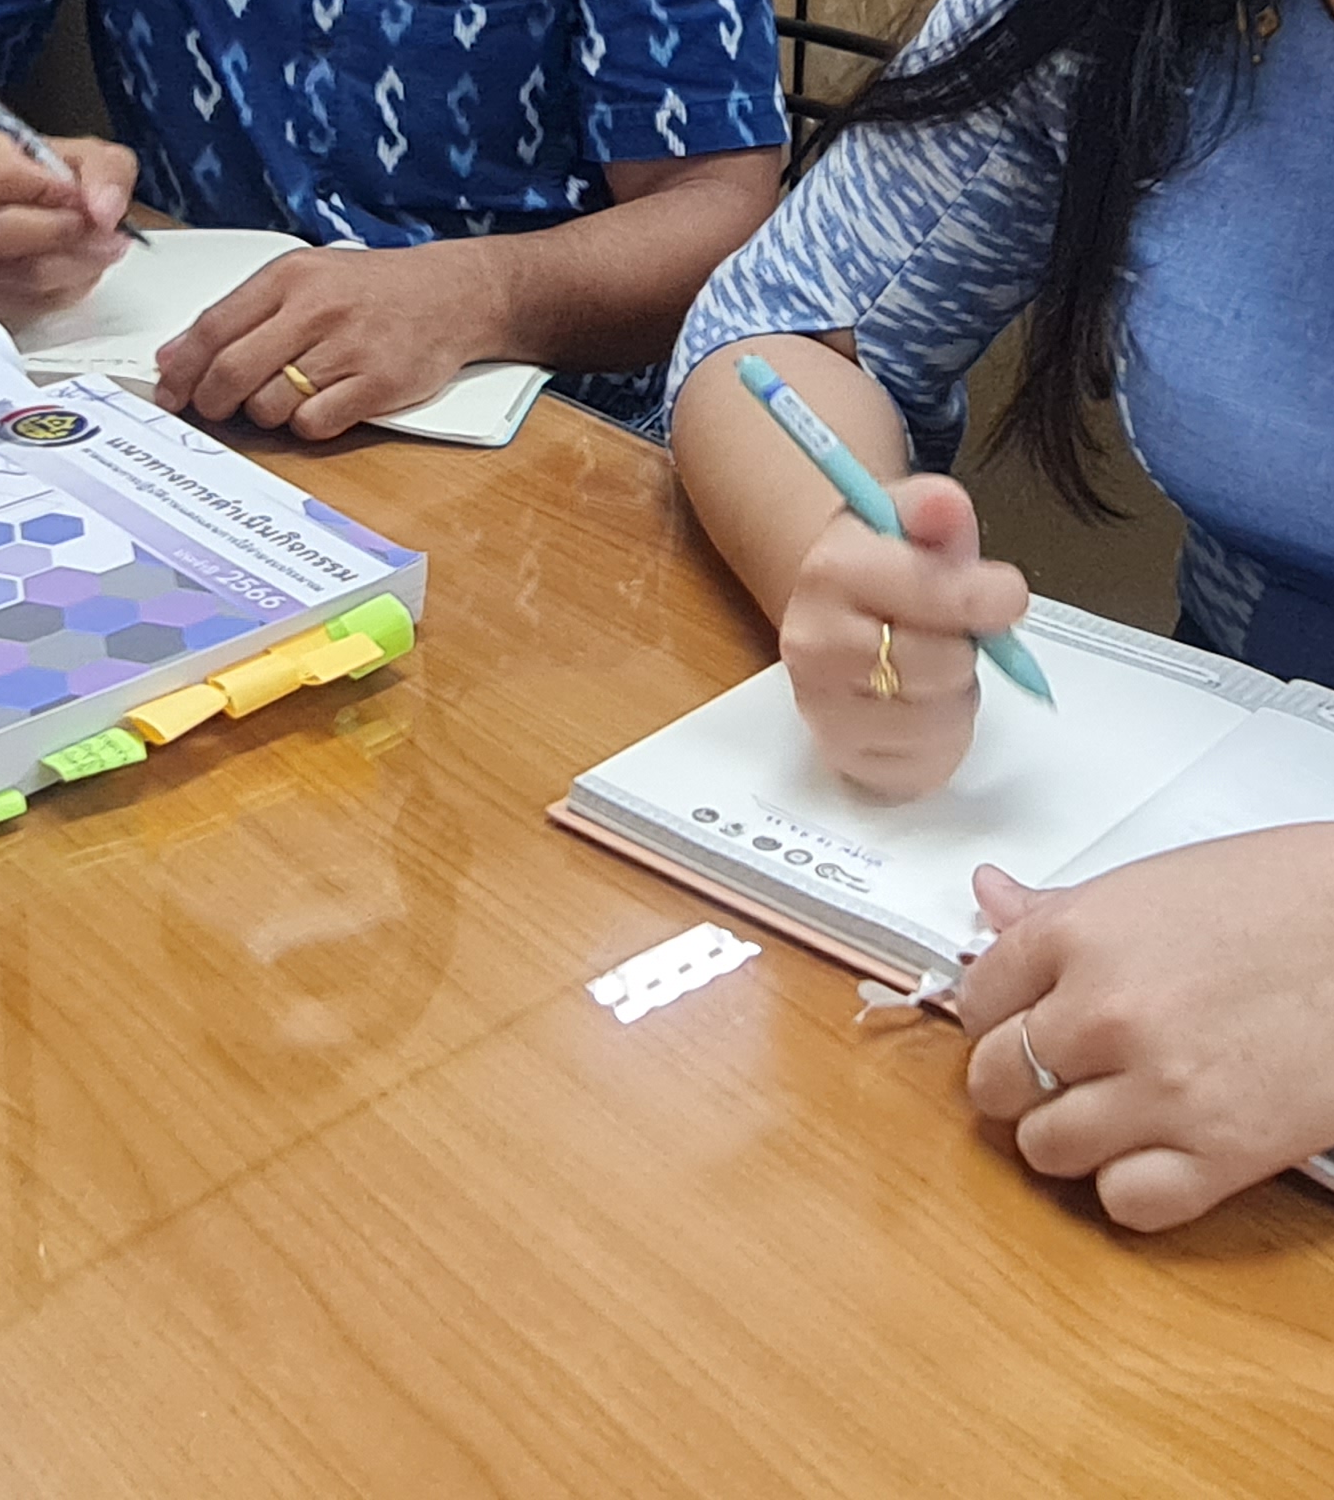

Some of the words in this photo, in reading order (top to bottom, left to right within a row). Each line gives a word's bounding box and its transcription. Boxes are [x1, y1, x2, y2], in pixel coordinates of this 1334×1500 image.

[105, 435, 360, 583] แนวทางการดำเนินกิจกรรม
[217, 567, 287, 610] 2566
